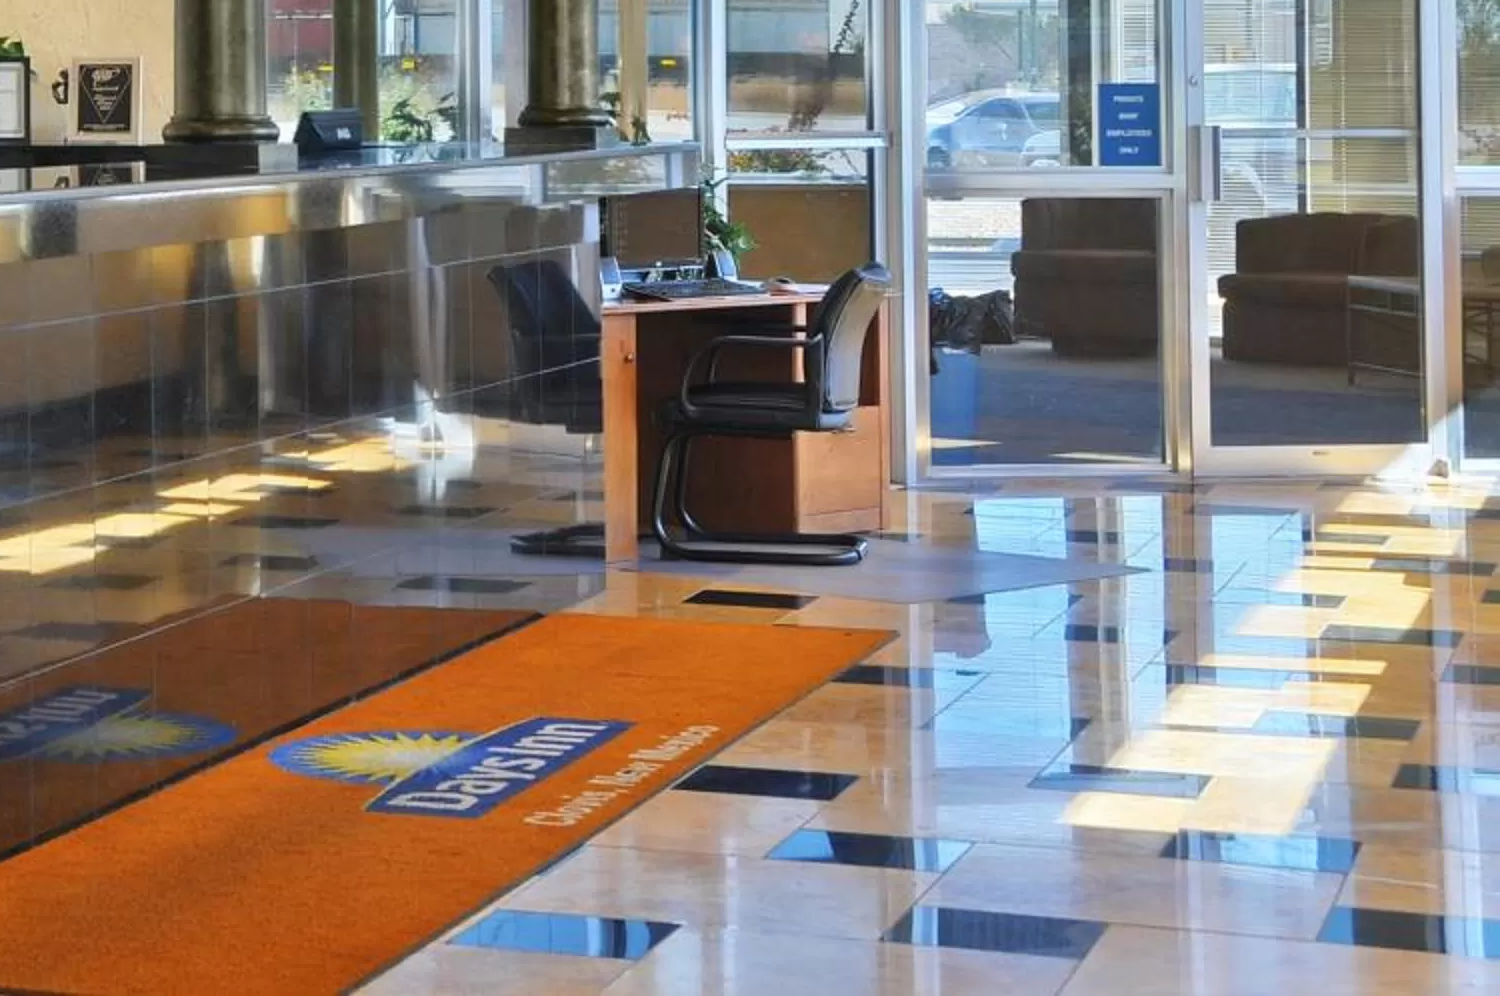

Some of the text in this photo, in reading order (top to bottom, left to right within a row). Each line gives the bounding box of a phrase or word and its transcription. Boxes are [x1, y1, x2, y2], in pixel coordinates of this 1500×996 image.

[387, 723, 608, 811] Days Inn
[628, 724, 720, 761] Mexico
